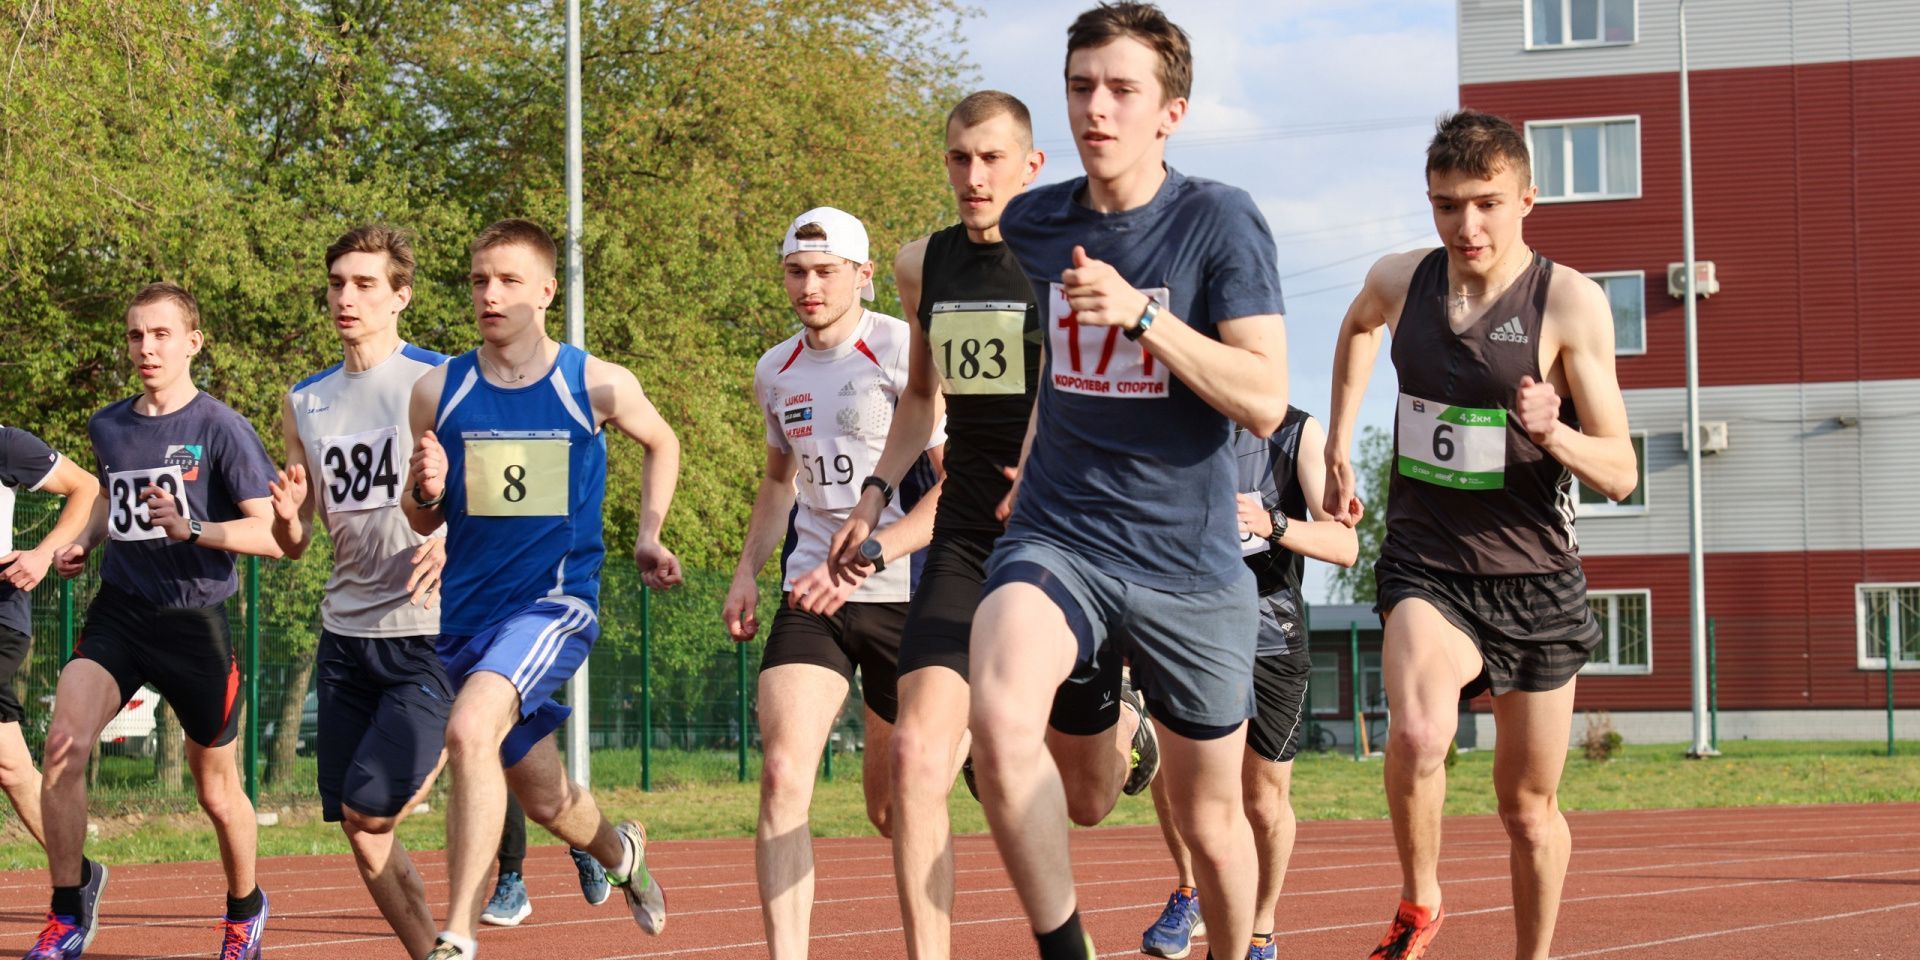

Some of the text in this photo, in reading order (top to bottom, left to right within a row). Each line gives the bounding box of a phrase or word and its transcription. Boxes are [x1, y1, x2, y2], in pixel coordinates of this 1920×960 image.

[1490, 332, 1528, 344] adidas
[940, 338, 1007, 380] 183
[784, 393, 813, 407] LUKOIL
[1055, 374, 1164, 393] КОРОЛЕВА СПОРТА
[1432, 423, 1455, 462] 6
[325, 437, 398, 503] 384
[503, 464, 527, 503] 8
[801, 453, 854, 487] 519
